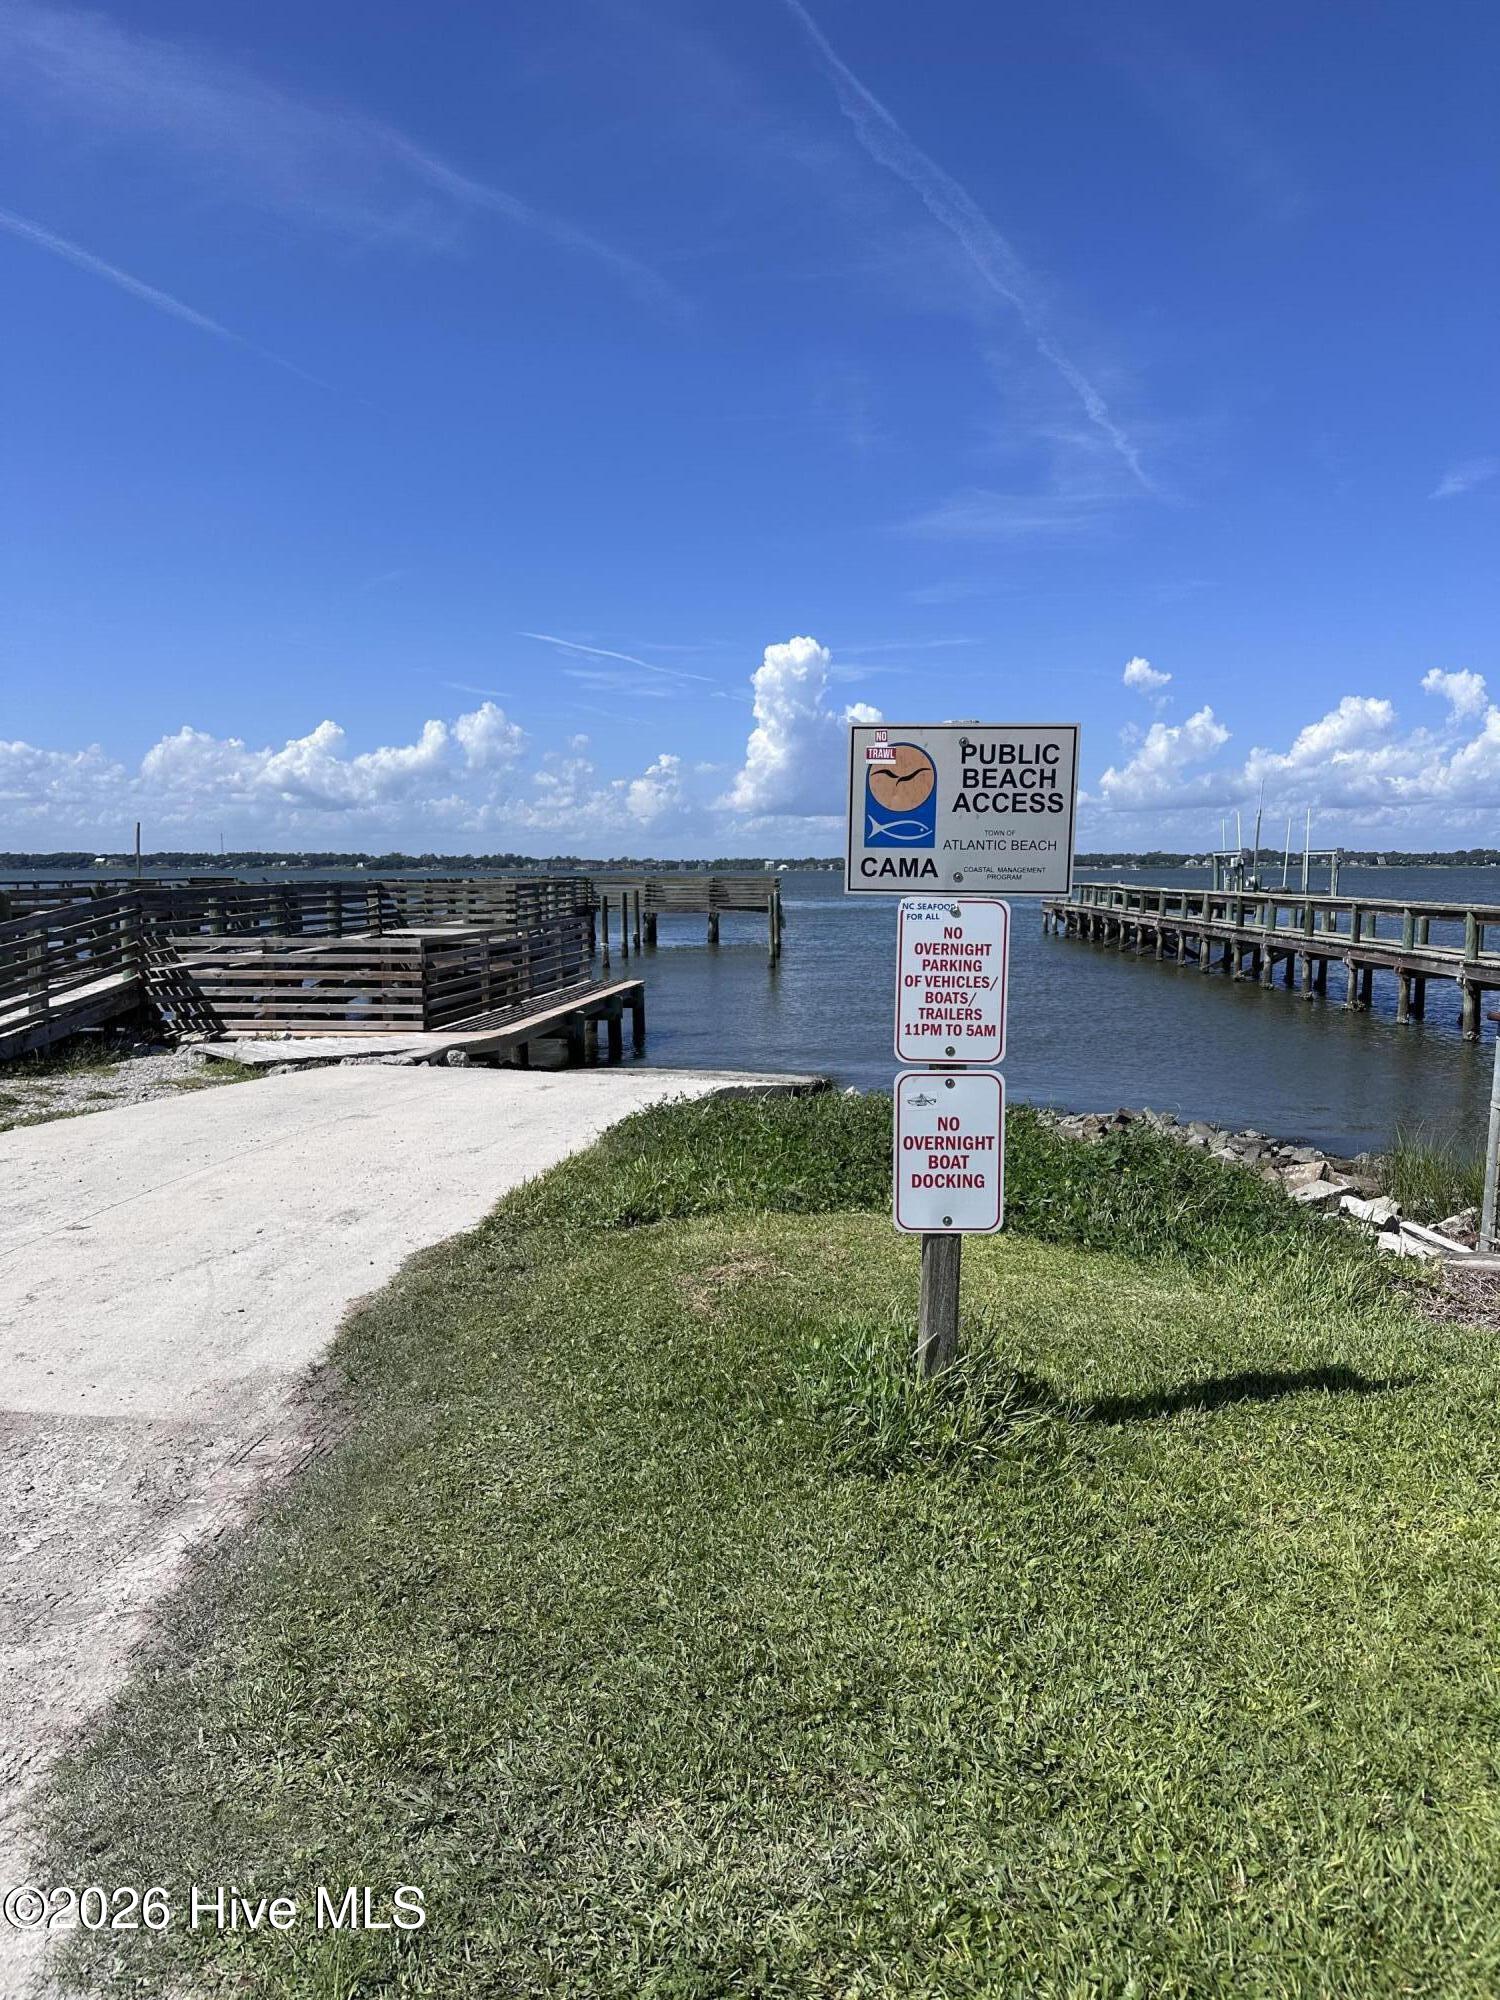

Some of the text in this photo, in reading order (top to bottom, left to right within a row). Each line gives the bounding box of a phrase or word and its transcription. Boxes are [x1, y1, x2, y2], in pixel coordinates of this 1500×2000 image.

[876, 731, 887, 742] NO
[868, 748, 895, 759] TRAWL
[961, 744, 1060, 765] PUBLIC
[962, 769, 1056, 789] BEACH
[952, 793, 1064, 813] ACCESS
[943, 840, 1057, 851] ATLANTIC BEACH
[861, 858, 938, 878] CAMA
[944, 927, 962, 939] NO
[914, 943, 992, 956] OVERNIGHT
[922, 960, 982, 972] PARKING
[905, 976, 998, 991] OF VEHICLES/
[925, 992, 976, 1007] BOATS/
[919, 1008, 982, 1020] TRAILERS
[905, 1024, 996, 1037] 11PM TO 5AM
[938, 1117, 960, 1131] NO
[903, 1136, 995, 1150] OVERNIGHT
[929, 1155, 969, 1169] BOAT
[912, 1174, 985, 1188] DOCKING
